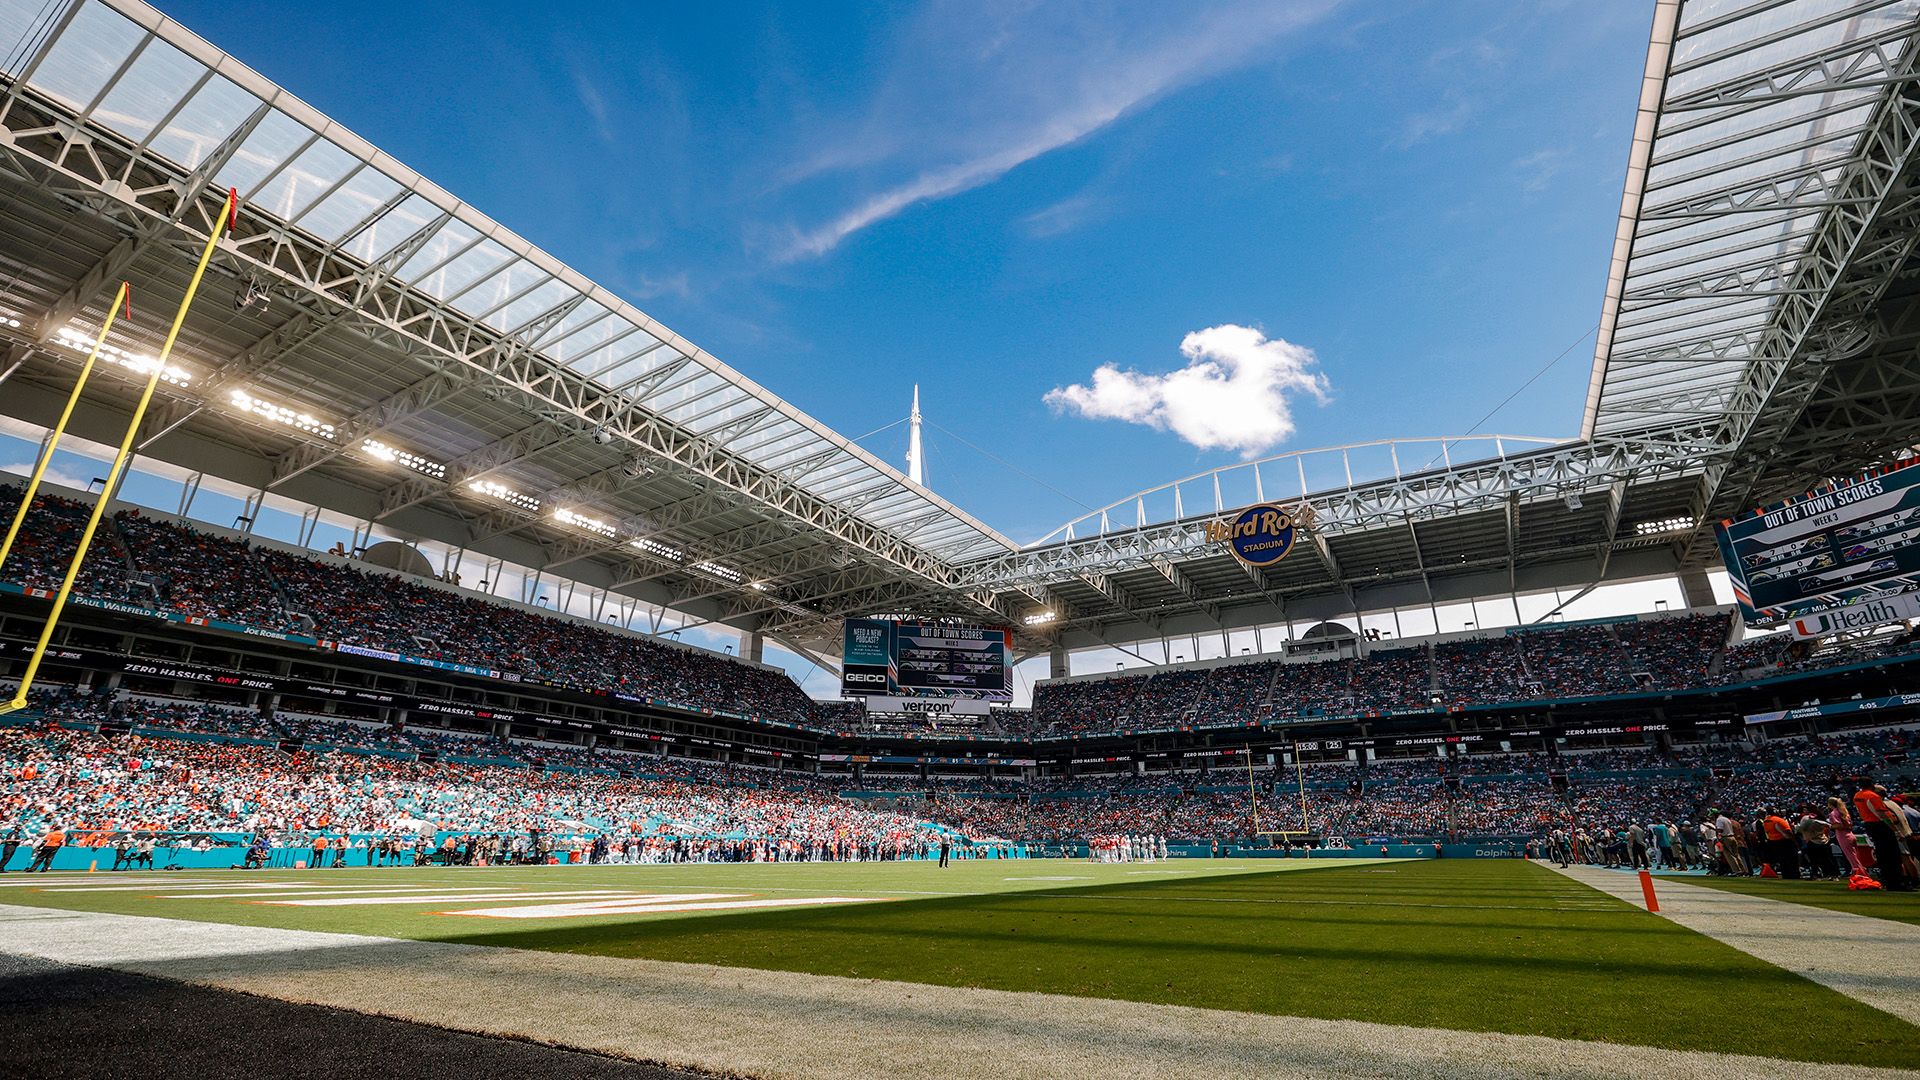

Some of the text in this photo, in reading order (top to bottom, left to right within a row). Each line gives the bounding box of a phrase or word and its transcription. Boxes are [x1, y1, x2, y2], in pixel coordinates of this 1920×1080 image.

[1764, 480, 1884, 528] OUT OF TOWN SCORES
[1204, 504, 1318, 544] Hard Rock
[1812, 512, 1839, 527] WEEK 3
[1243, 539, 1284, 552] STADIUM
[1874, 538, 1885, 546] 10
[1879, 589, 1898, 597] 15:00
[75, 597, 169, 620] PAUL WARFIELD 42
[1811, 599, 1848, 613] MIA 14
[1756, 616, 1773, 625] DEN
[244, 626, 287, 641] JOE ROBBIE
[853, 628, 866, 636] NEED
[870, 629, 882, 637] NEW
[920, 627, 983, 640] OUT OF TOWN SCORES
[856, 635, 880, 644] PODCAST?
[340, 645, 394, 661] ticketmaster
[420, 658, 434, 667] DEN
[465, 666, 477, 674] MIA
[124, 663, 275, 690] ZERO HASSLES. ONE PRICE.
[846, 673, 886, 683] GEICO
[902, 701, 950, 713] verizon
[1790, 706, 1818, 715] PANTHERS
[1859, 702, 1877, 710] 4:05
[418, 703, 440, 712] ZERO
[440, 706, 476, 717] HASSLES.
[493, 713, 515, 721] PRICE.
[1792, 711, 1822, 719] SEAHAWKS
[609, 729, 625, 737] ZERO
[625, 731, 649, 740] HASSLES.
[1586, 727, 1624, 735] HASSLES.
[1413, 737, 1445, 745] HASSLES.
[1298, 742, 1318, 750] 15:00
[755, 748, 772, 756] HASSLES.
